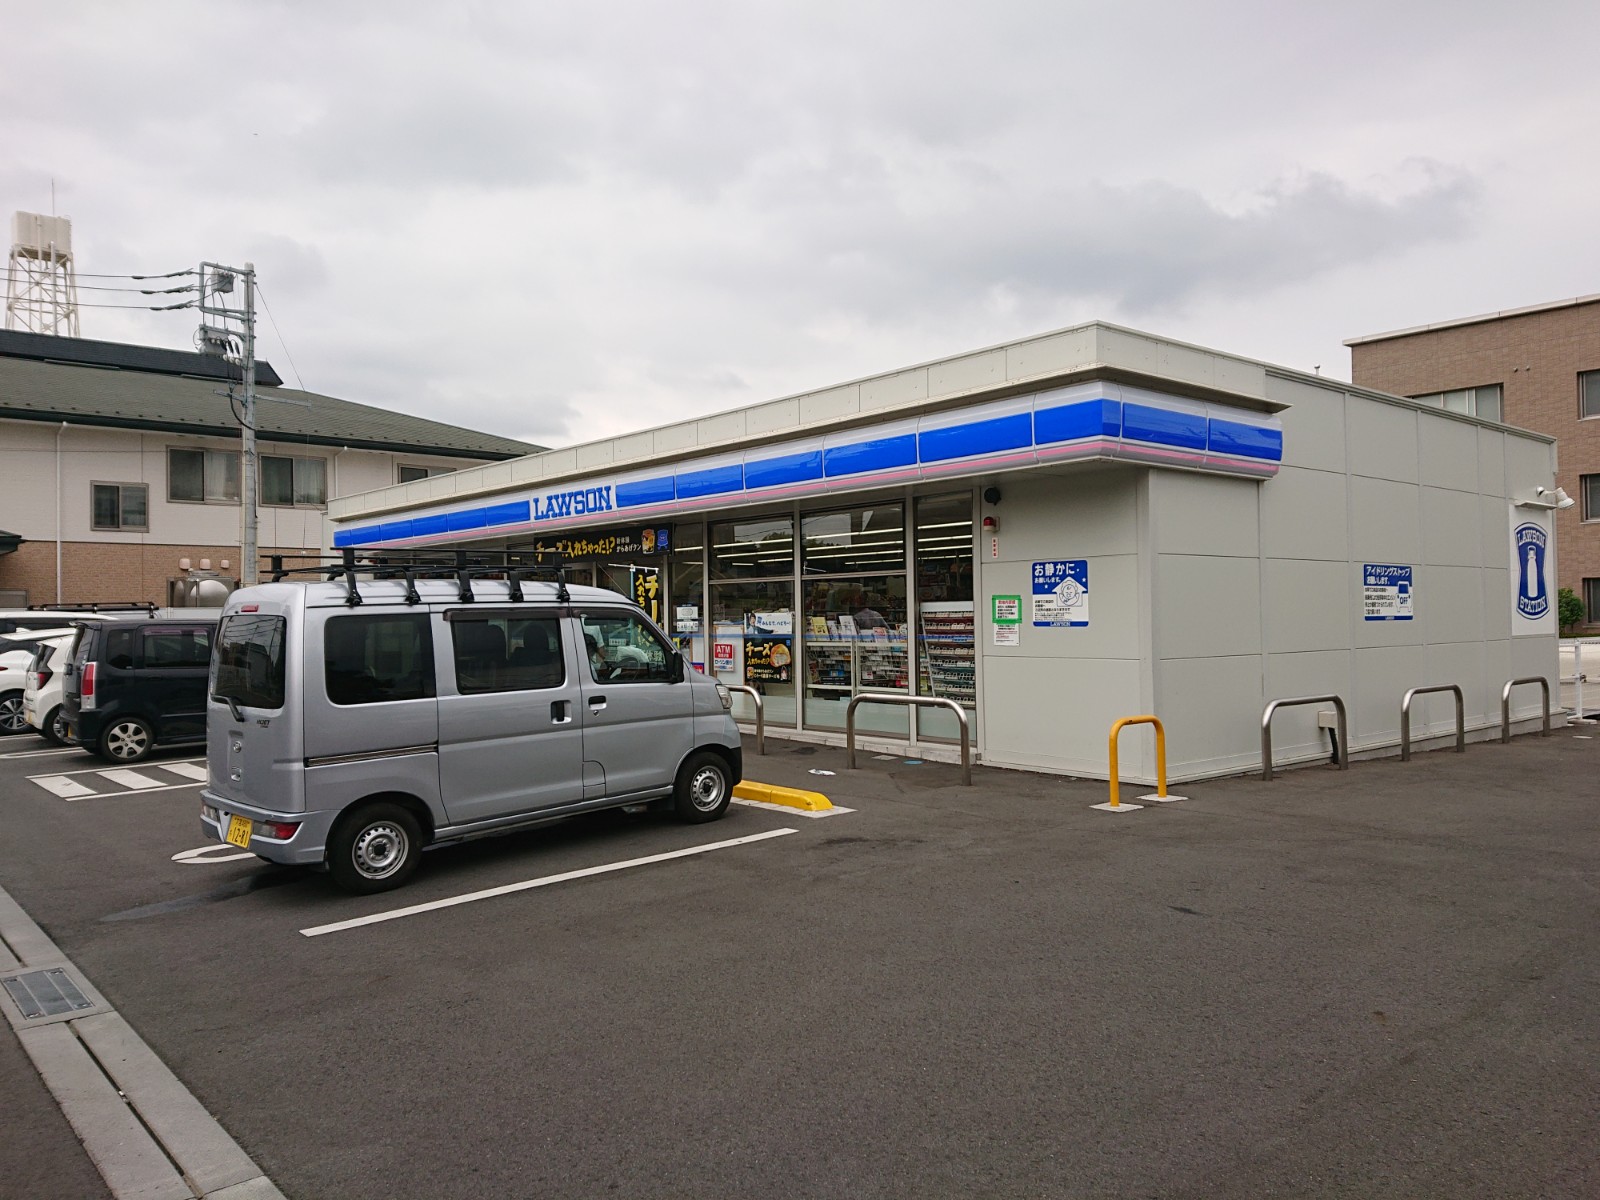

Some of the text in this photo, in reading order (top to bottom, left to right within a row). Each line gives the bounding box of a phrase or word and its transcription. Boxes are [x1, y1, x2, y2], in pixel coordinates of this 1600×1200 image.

[533, 486, 612, 520] LAWSON
[1517, 529, 1546, 549] LAWSON
[1034, 562, 1075, 576] お静かに
[1366, 566, 1411, 577] アイドリングストップ
[1519, 595, 1547, 613] STATION
[717, 645, 731, 653] ATM
[746, 641, 773, 657] チーズ
